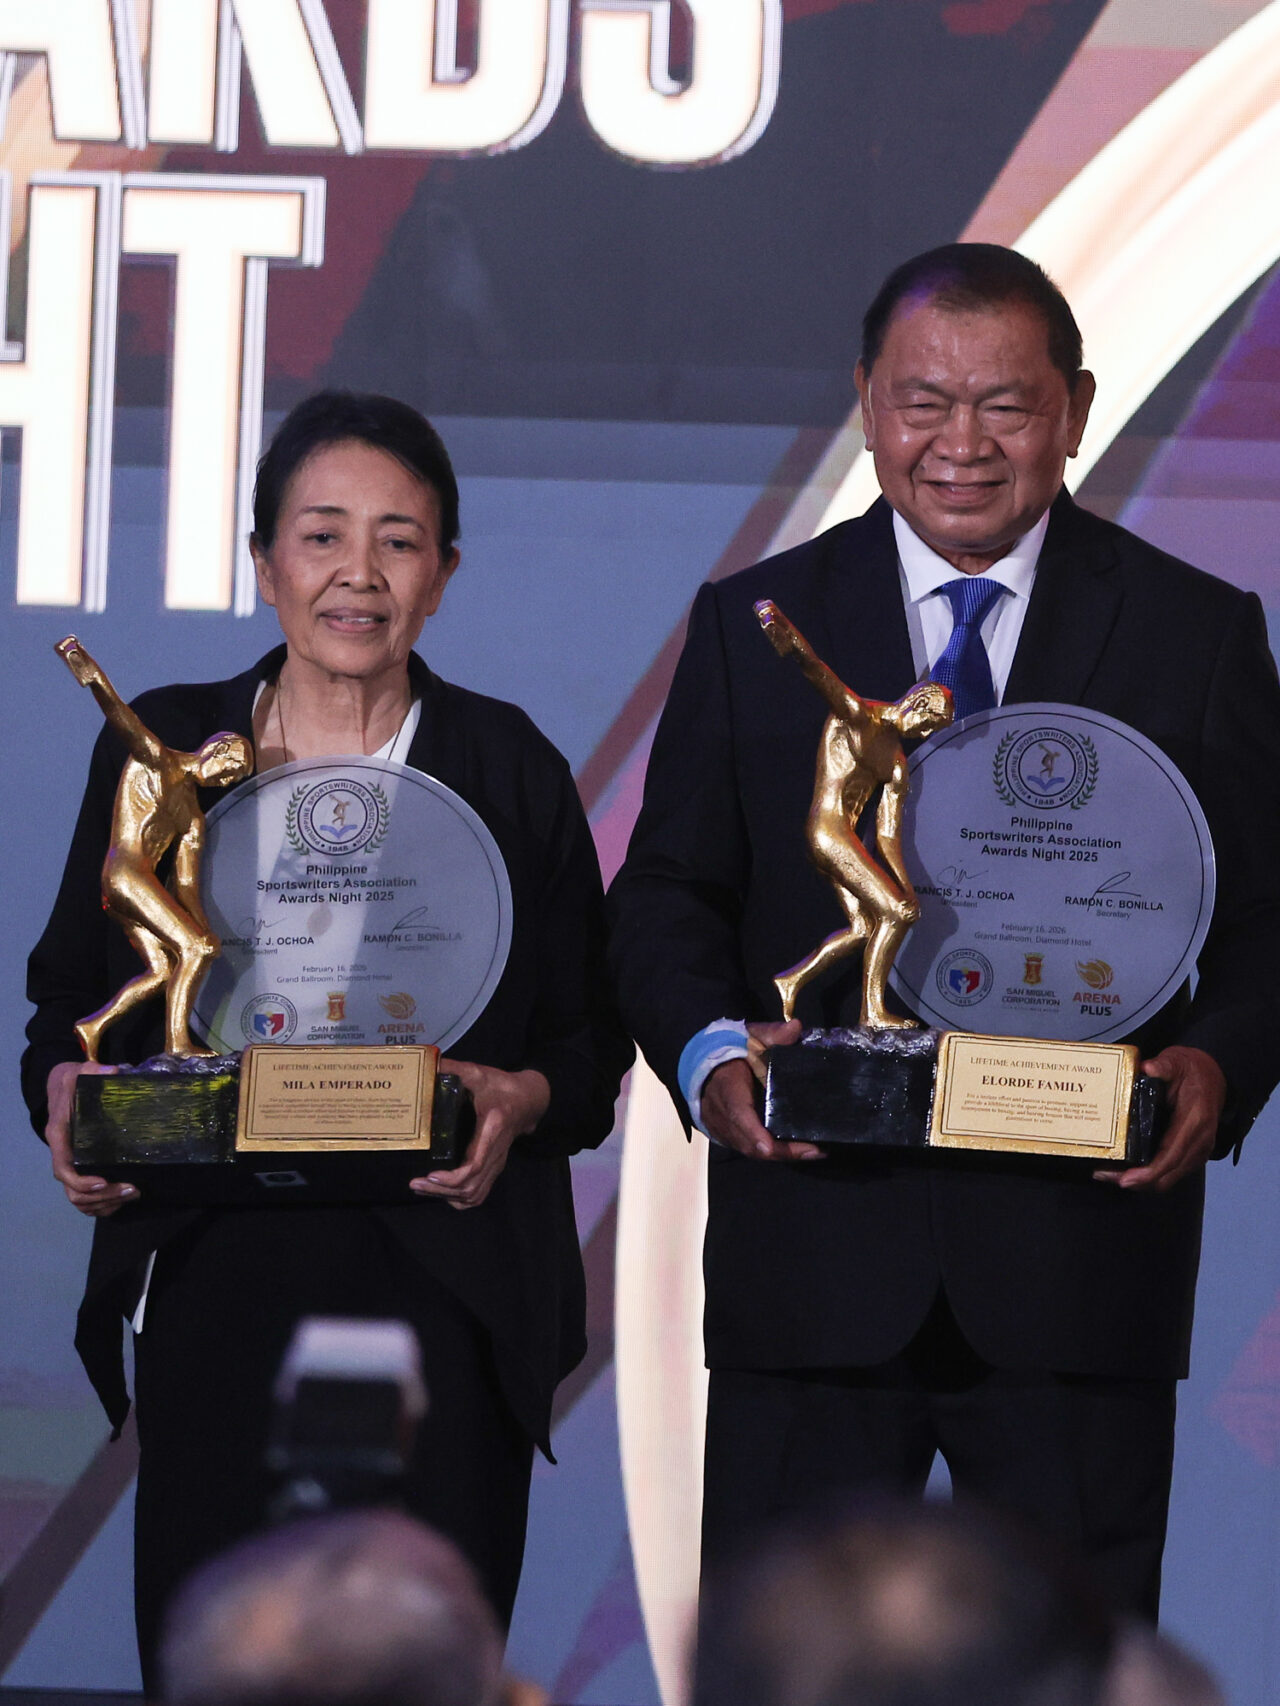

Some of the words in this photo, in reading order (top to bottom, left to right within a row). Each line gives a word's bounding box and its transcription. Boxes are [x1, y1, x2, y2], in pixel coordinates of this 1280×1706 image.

[1010, 817, 1072, 832] Philippine
[959, 829, 1044, 846] Sportswriters
[1047, 834, 1121, 848] Association
[981, 845, 1027, 858] Awards
[1031, 848, 1064, 862] Night
[1069, 850, 1098, 862] 2025
[306, 864, 367, 877] Philippine
[256, 879, 340, 892] Sportswriters
[342, 877, 416, 888] Association
[278, 893, 324, 903] Awards
[329, 892, 361, 905] Night
[365, 891, 393, 901] 2025
[913, 886, 952, 897] RANCIS
[965, 889, 973, 898] J.
[977, 890, 1014, 900] OCHOA
[1064, 896, 1102, 907] RAMON
[1118, 900, 1163, 911] BONILLA
[222, 938, 252, 946] ANCIS
[265, 937, 273, 945] J.
[276, 936, 314, 945] OCHOA
[363, 934, 401, 943] RAMON
[1001, 997, 1062, 1006] CORPORATION
[1072, 993, 1121, 1005] ARENA
[1080, 1006, 1111, 1016] PLUS
[376, 1023, 425, 1033] ARENA
[385, 1035, 415, 1044] PLUS
[970, 1057, 1008, 1067] LIFETIME
[1010, 1060, 1069, 1071] ACHIEVEMENT
[1071, 1064, 1102, 1074] AWARD
[283, 1081, 314, 1089] MILA
[319, 1081, 391, 1089] EMPERADO
[982, 1076, 1034, 1089] ELORDE
[1038, 1080, 1085, 1092] FAMILY
